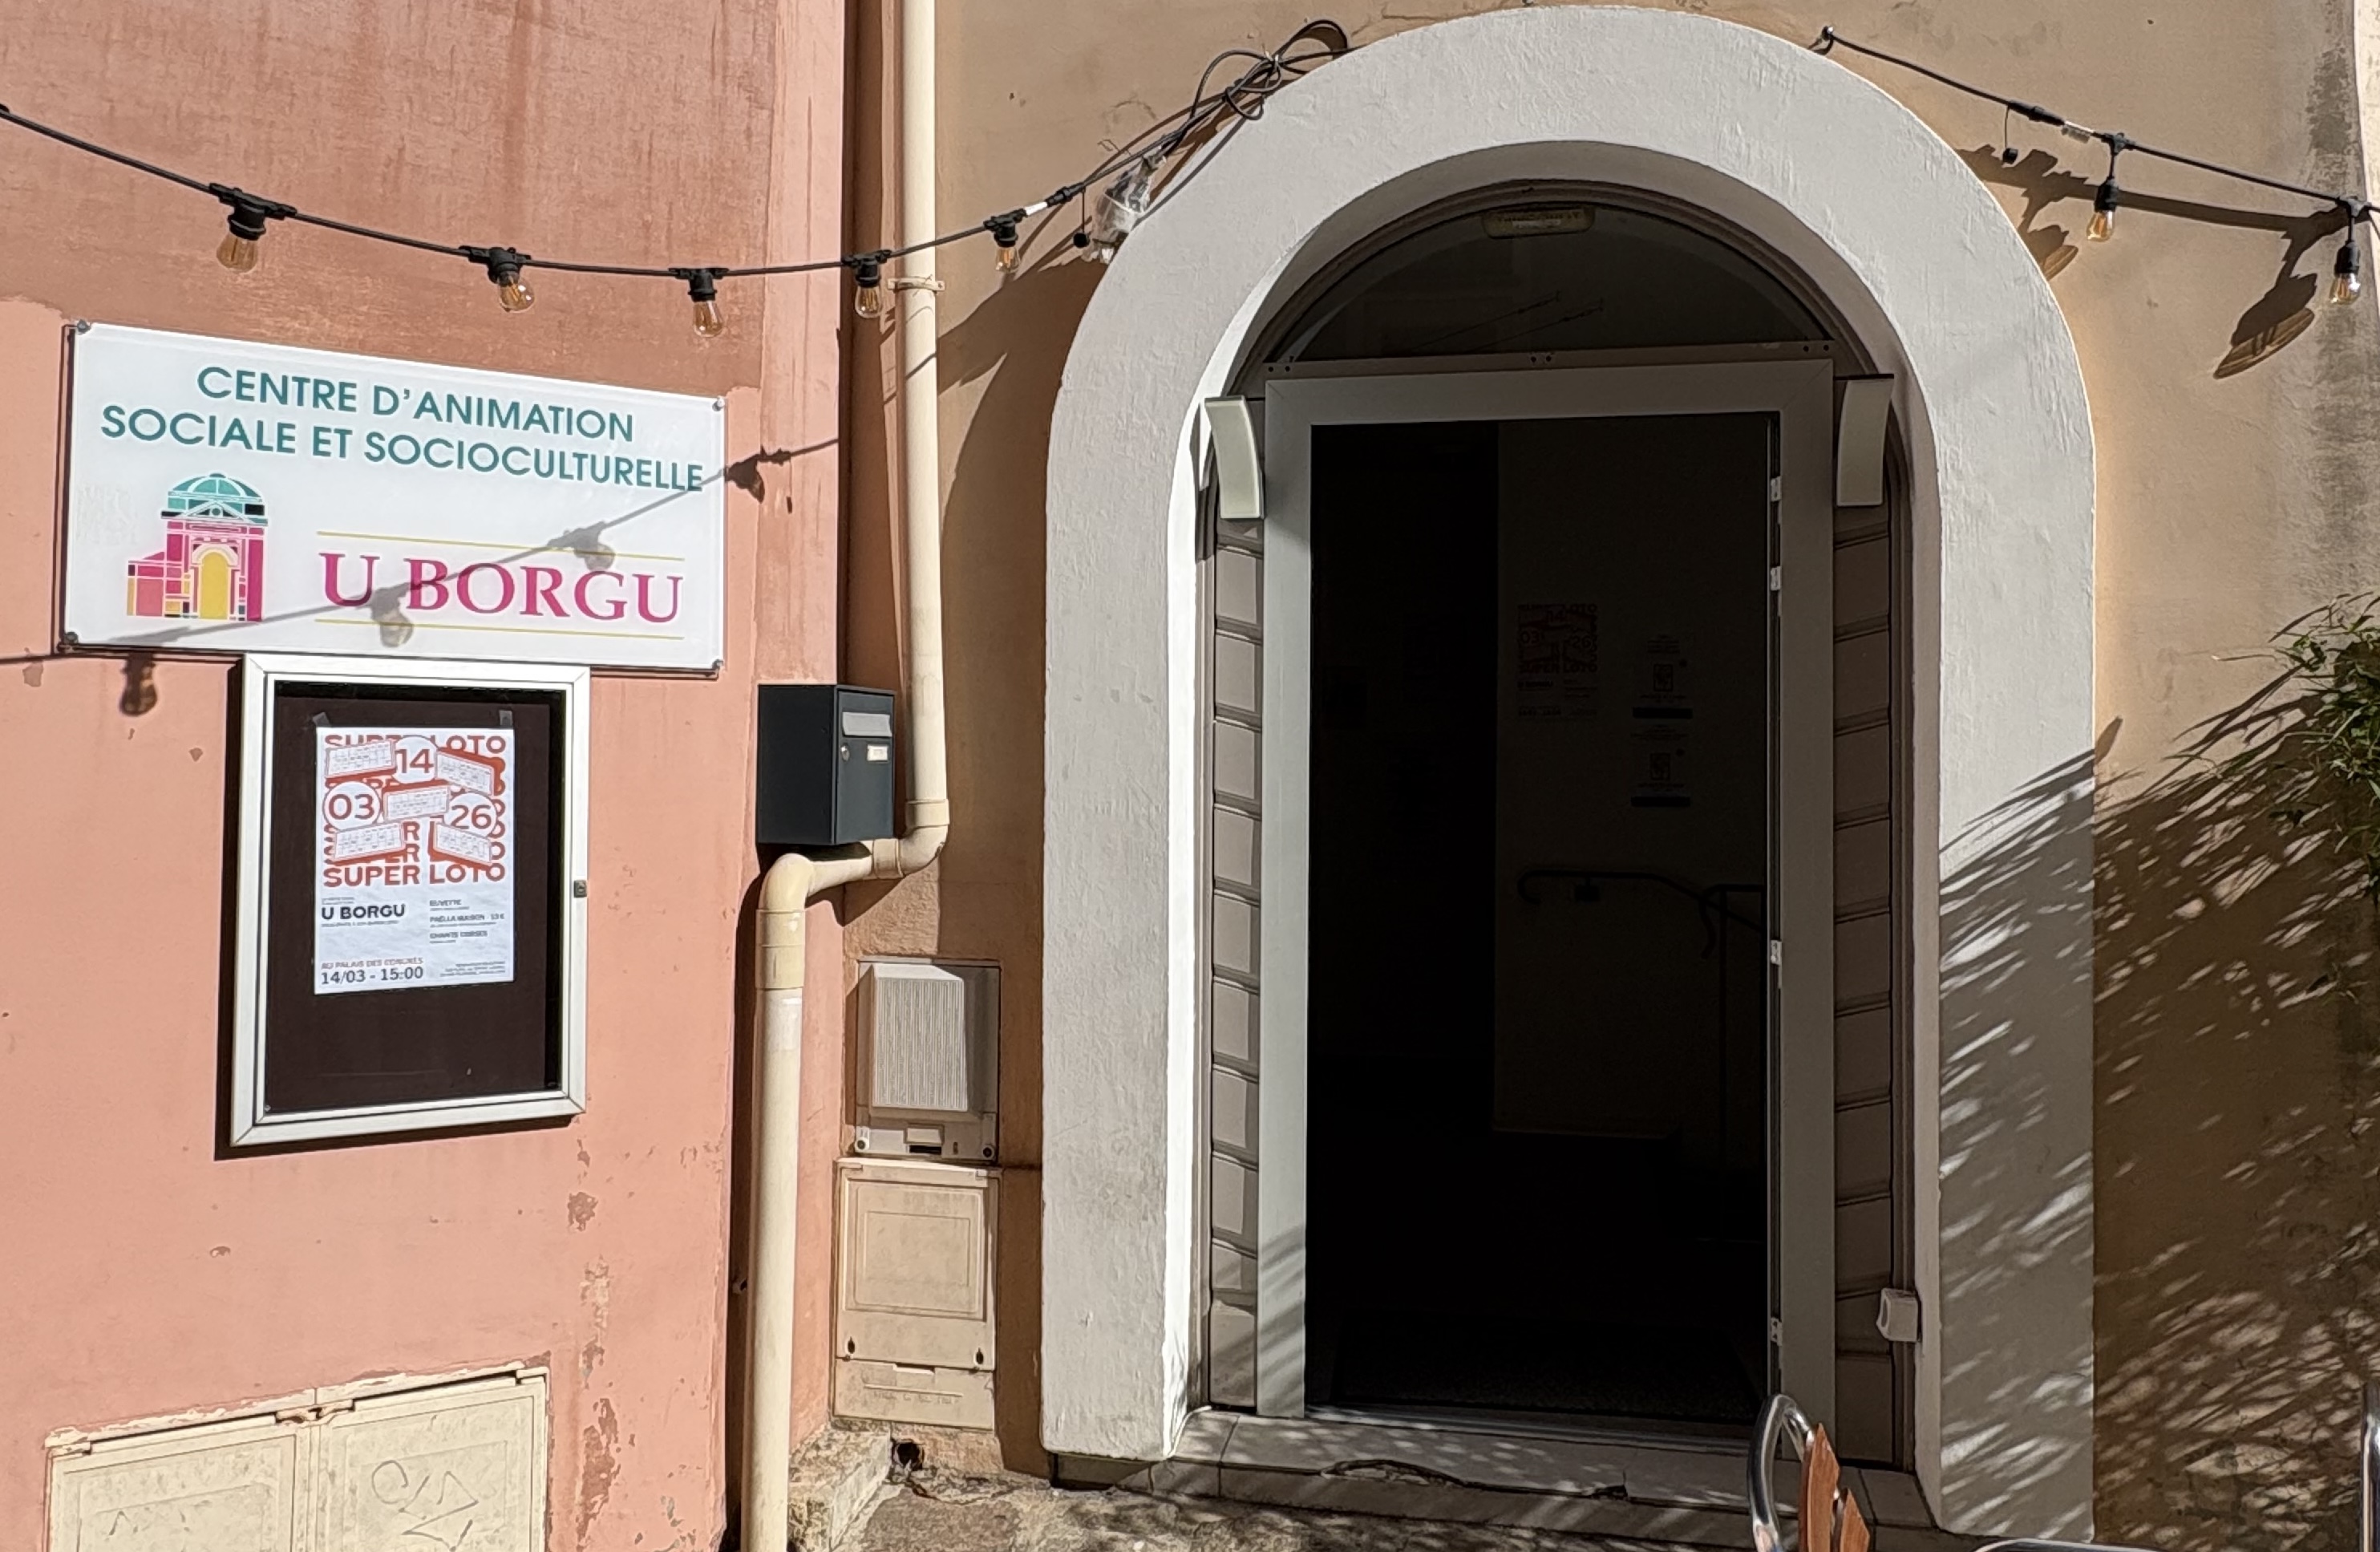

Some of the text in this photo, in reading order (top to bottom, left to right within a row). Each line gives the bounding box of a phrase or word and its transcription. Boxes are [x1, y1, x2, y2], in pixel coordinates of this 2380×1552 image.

[197, 366, 634, 443] CENTRE D'ANIMATION
[101, 404, 704, 492] SOCIALE ET SOCIOCULTURELLE
[320, 552, 683, 624] U BORGU
[395, 748, 435, 775] 14
[328, 793, 375, 821] 03
[451, 804, 492, 831] 26
[323, 863, 506, 888] SUPER LOTO
[322, 903, 406, 920] U BORGU
[322, 969, 366, 985] 14/03
[381, 966, 424, 981] 15:00
